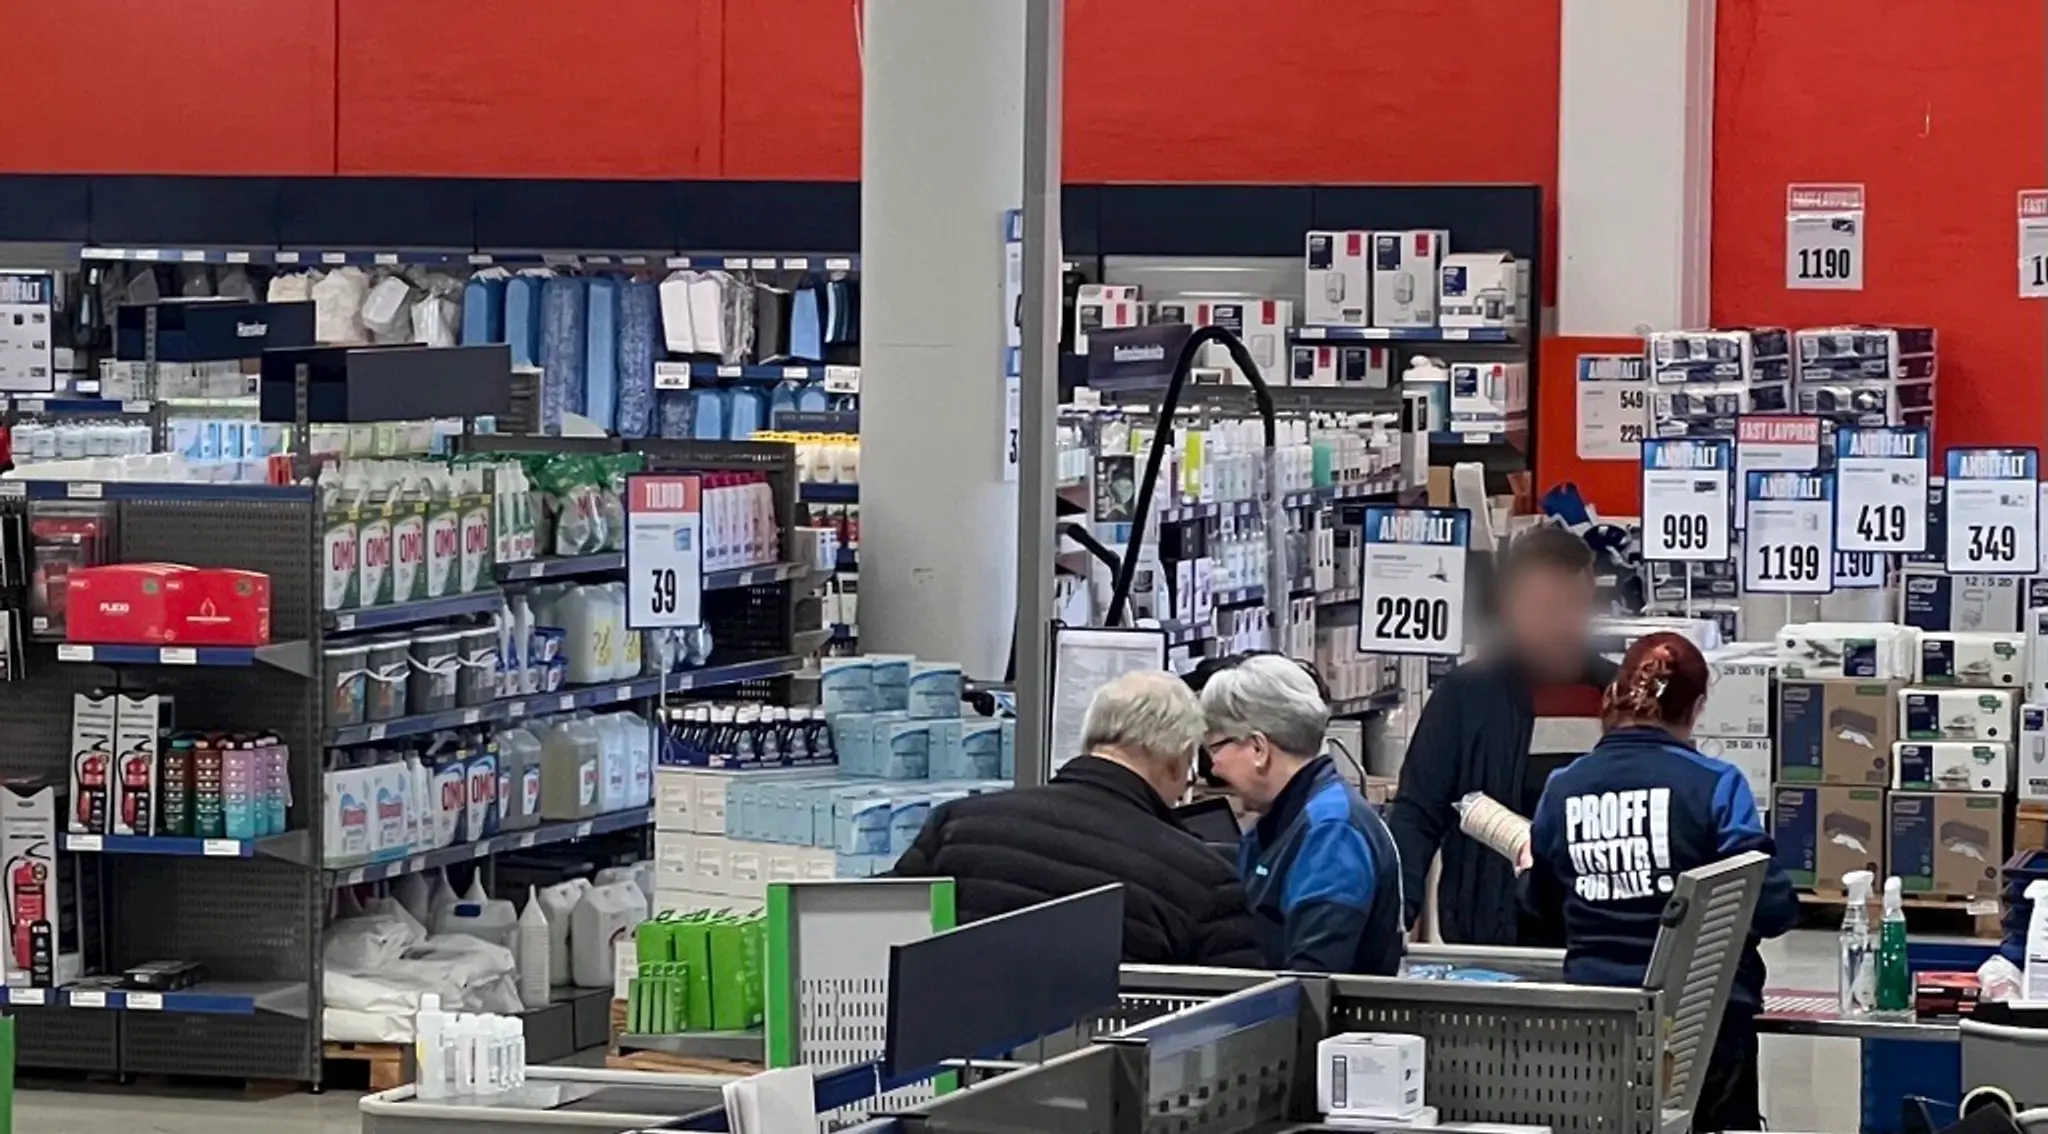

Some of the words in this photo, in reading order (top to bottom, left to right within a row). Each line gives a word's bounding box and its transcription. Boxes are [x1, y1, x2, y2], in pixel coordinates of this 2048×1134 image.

[1799, 249, 1850, 278] 1190
[1620, 390, 1643, 409] 549
[1740, 422, 1766, 441] FAST
[1768, 423, 1817, 442] LAVPRIS
[1850, 434, 1917, 456] ANBEFALT
[1655, 446, 1718, 467] ANBEFALT
[1960, 456, 2026, 478] ANBEFALT
[645, 482, 684, 508] TILBUD
[1760, 477, 1822, 499] ANBEFALT
[1379, 515, 1455, 542] ANBEFALT
[1663, 514, 1708, 549] 999
[1857, 504, 1906, 542] 419
[1968, 526, 2016, 561] 349
[1759, 545, 1819, 580] 1199
[652, 569, 677, 614] 39
[1376, 596, 1448, 641] 2290
[1566, 789, 1648, 843] PROFF
